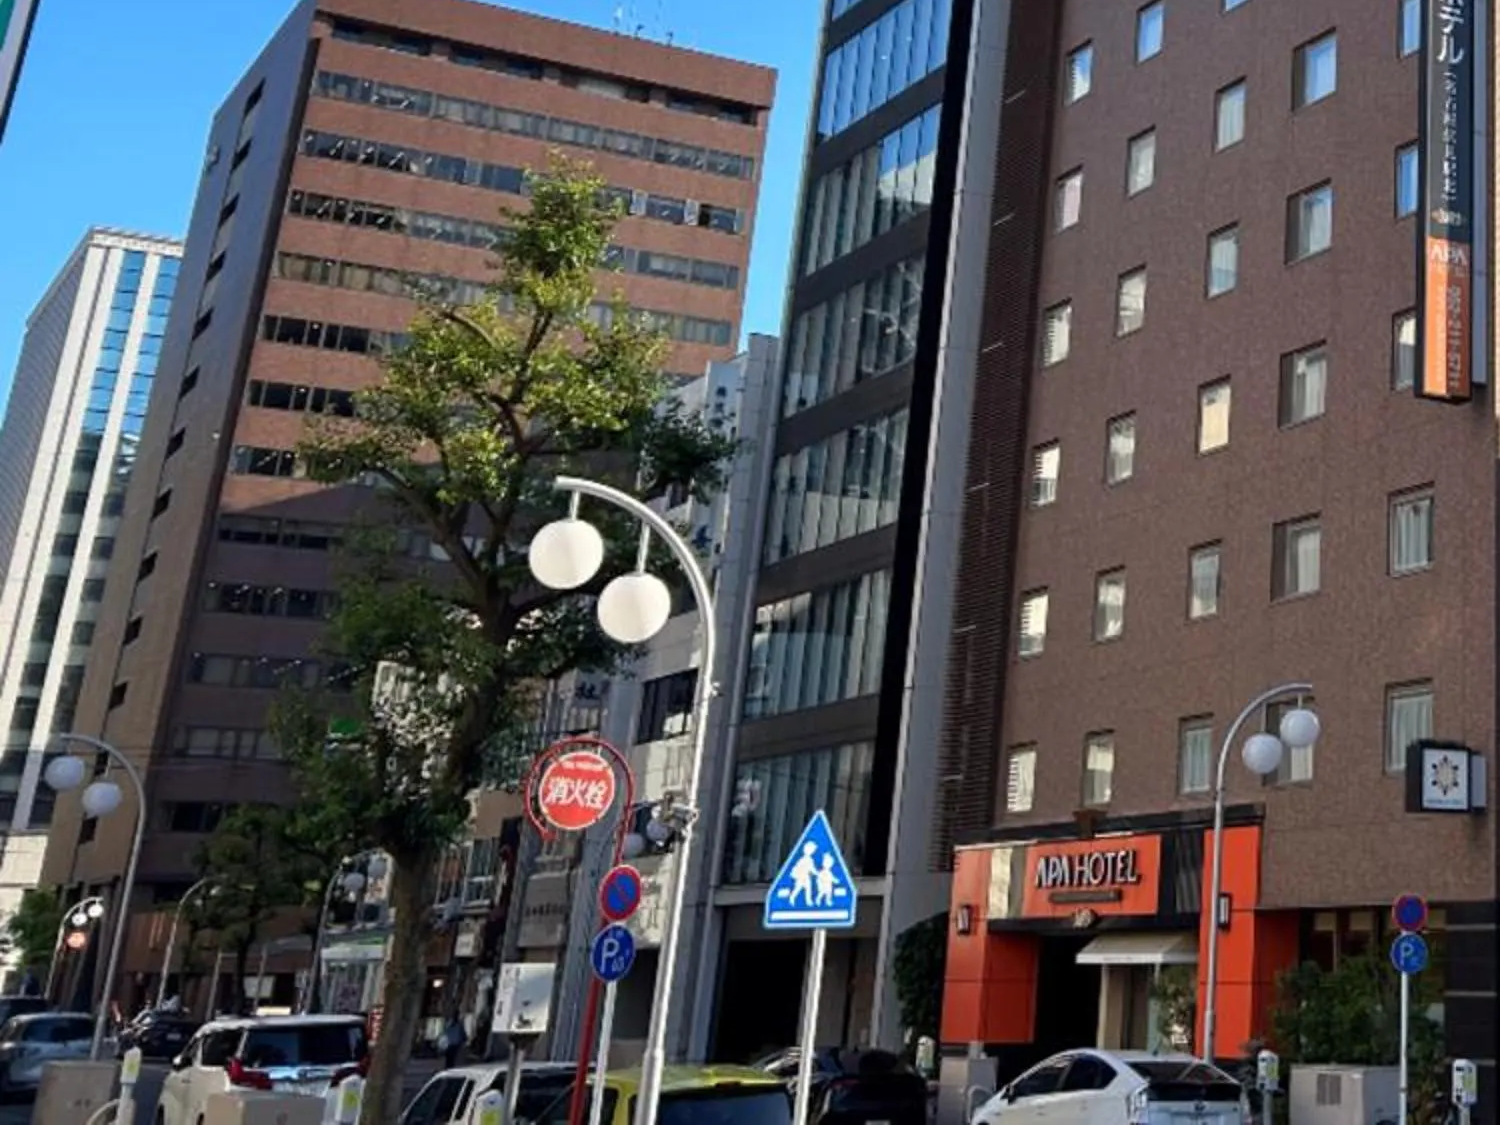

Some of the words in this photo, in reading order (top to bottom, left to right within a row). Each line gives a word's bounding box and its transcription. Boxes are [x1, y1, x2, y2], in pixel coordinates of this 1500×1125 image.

[543, 776, 609, 810] 消火栓
[1035, 856, 1070, 888] APA
[1073, 850, 1139, 886] HOTEL
[600, 938, 620, 974] P
